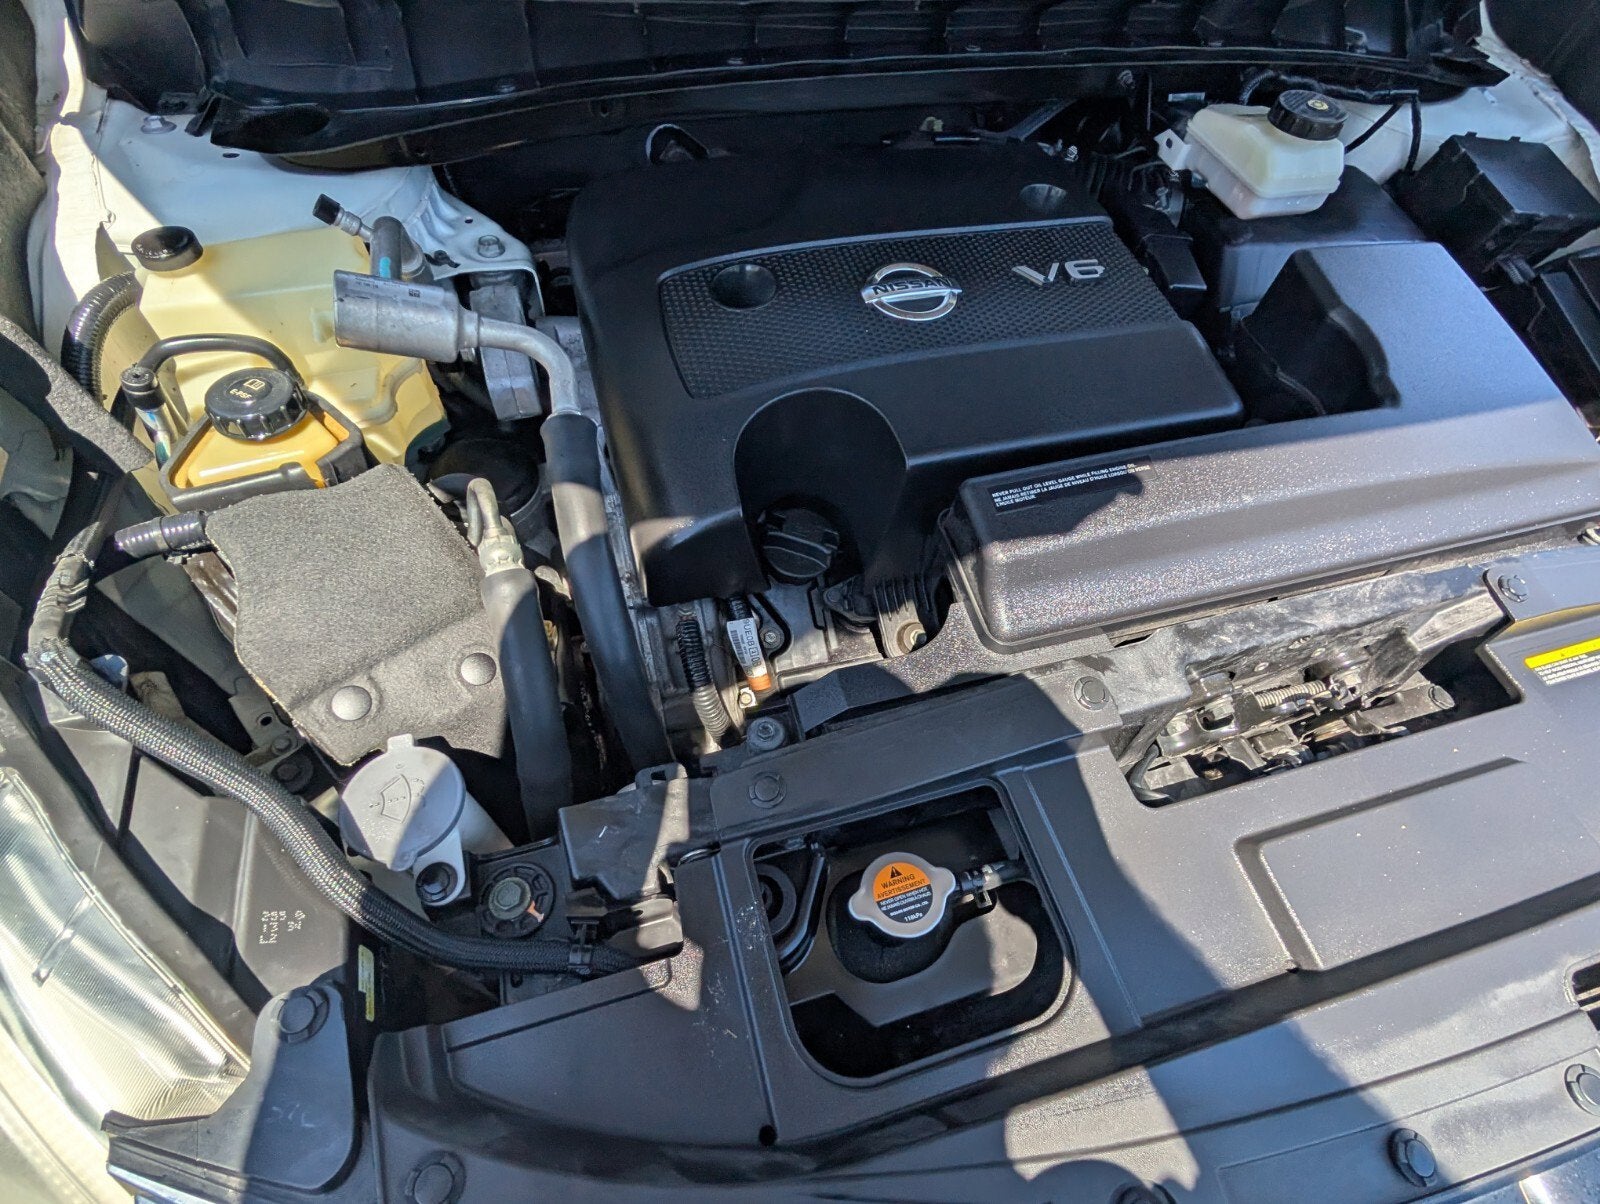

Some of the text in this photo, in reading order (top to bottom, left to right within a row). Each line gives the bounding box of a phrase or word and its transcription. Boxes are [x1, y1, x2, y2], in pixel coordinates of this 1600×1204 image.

[1012, 259, 1106, 286] V6
[872, 277, 952, 296] NISSAN
[991, 490, 1009, 498] NEVER
[1042, 479, 1058, 487] LEVEL
[1057, 475, 1076, 483] GAUGE
[1075, 472, 1091, 480] WHILE
[1091, 468, 1109, 476] FILLING
[1002, 493, 1020, 501] JAMAIS
[1020, 488, 1041, 497] RETIRER
[1048, 483, 1064, 491] JAUGE
[1071, 478, 1090, 486] NIVEAU
[877, 878, 926, 900] AVERTISSEMENT
[880, 873, 916, 890] WARNING
